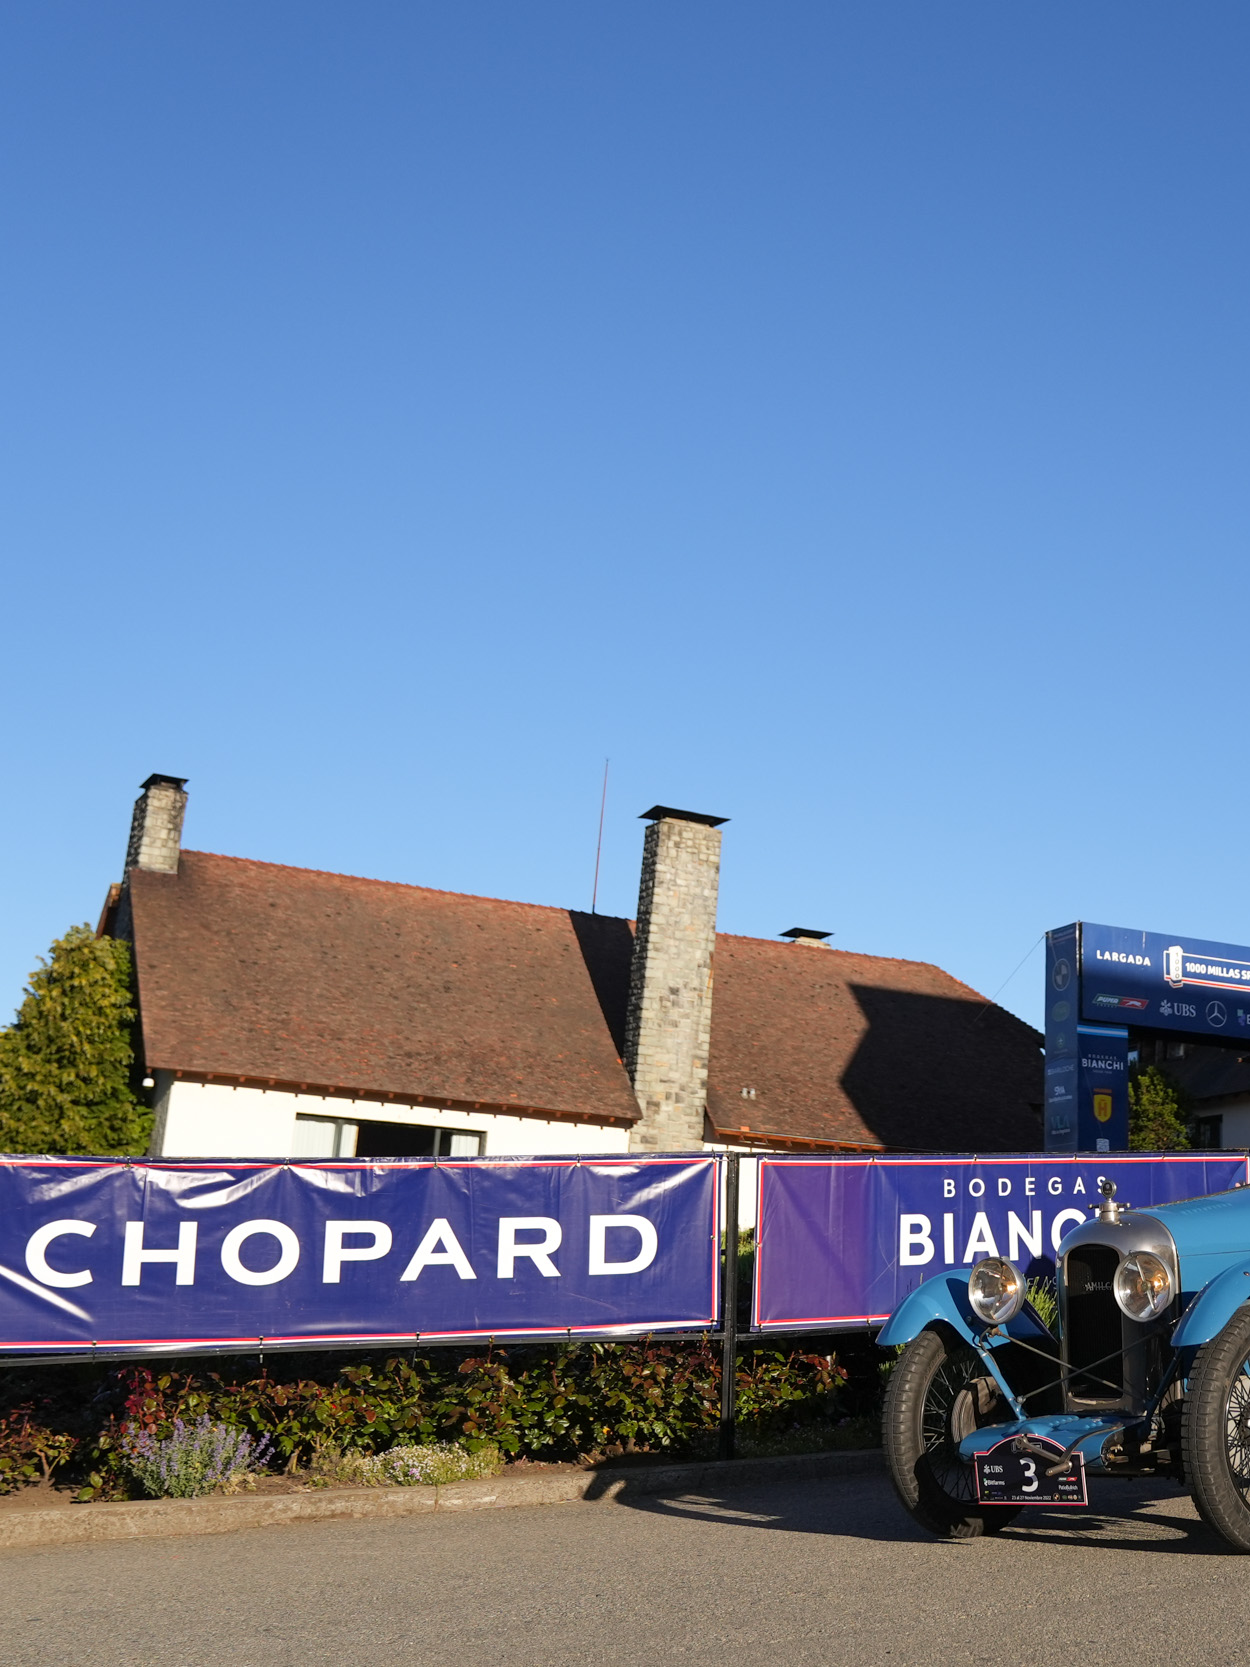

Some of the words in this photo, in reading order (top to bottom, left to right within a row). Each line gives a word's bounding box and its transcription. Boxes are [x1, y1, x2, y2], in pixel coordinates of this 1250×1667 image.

[1096, 949, 1151, 967] LARGADA
[1185, 962, 1206, 974] 1000
[1207, 964, 1241, 979] MILLAS
[1174, 1002, 1197, 1017] UBS
[1081, 1058, 1124, 1071] BIANCHI
[943, 1176, 1106, 1199] BODEGAS
[899, 1207, 1124, 1266] BIANC
[24, 1214, 659, 1289] CHOPARD
[990, 1465, 1004, 1473] UBS
[1019, 1457, 1039, 1493] 3
